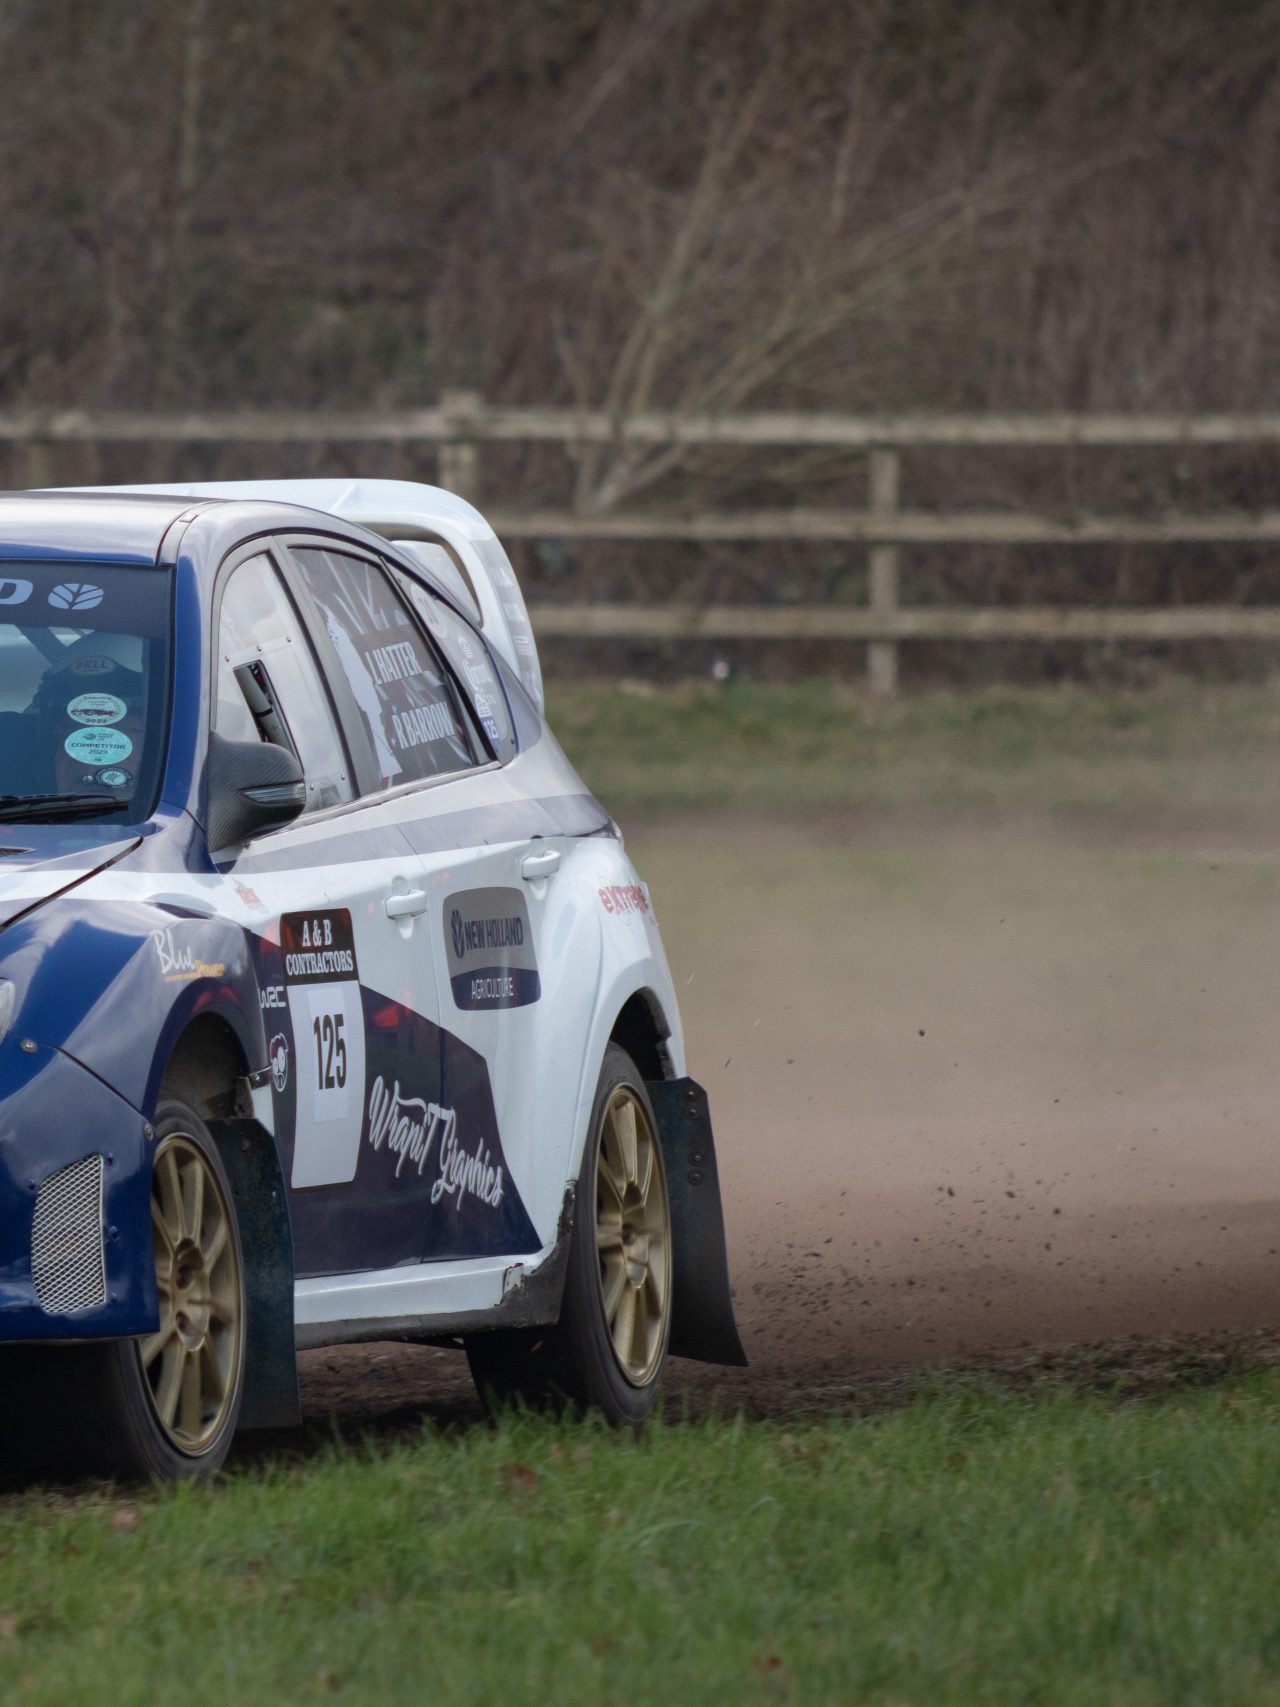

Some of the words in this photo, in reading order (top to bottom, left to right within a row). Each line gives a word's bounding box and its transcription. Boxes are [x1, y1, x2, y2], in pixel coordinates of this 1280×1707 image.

[372, 641, 423, 684] HATTER
[400, 701, 456, 747] BARROW
[71, 742, 126, 750] COMPETITOR
[302, 920, 311, 947] A
[313, 919, 322, 946] &
[324, 919, 333, 945] B
[464, 919, 486, 951] NEW
[486, 917, 524, 949] HOLLAND
[285, 949, 354, 976] CONTRACTORS
[471, 977, 515, 1000] AGRICULTURE
[313, 1013, 347, 1091] 125
[431, 1106, 505, 1212] Graphics
